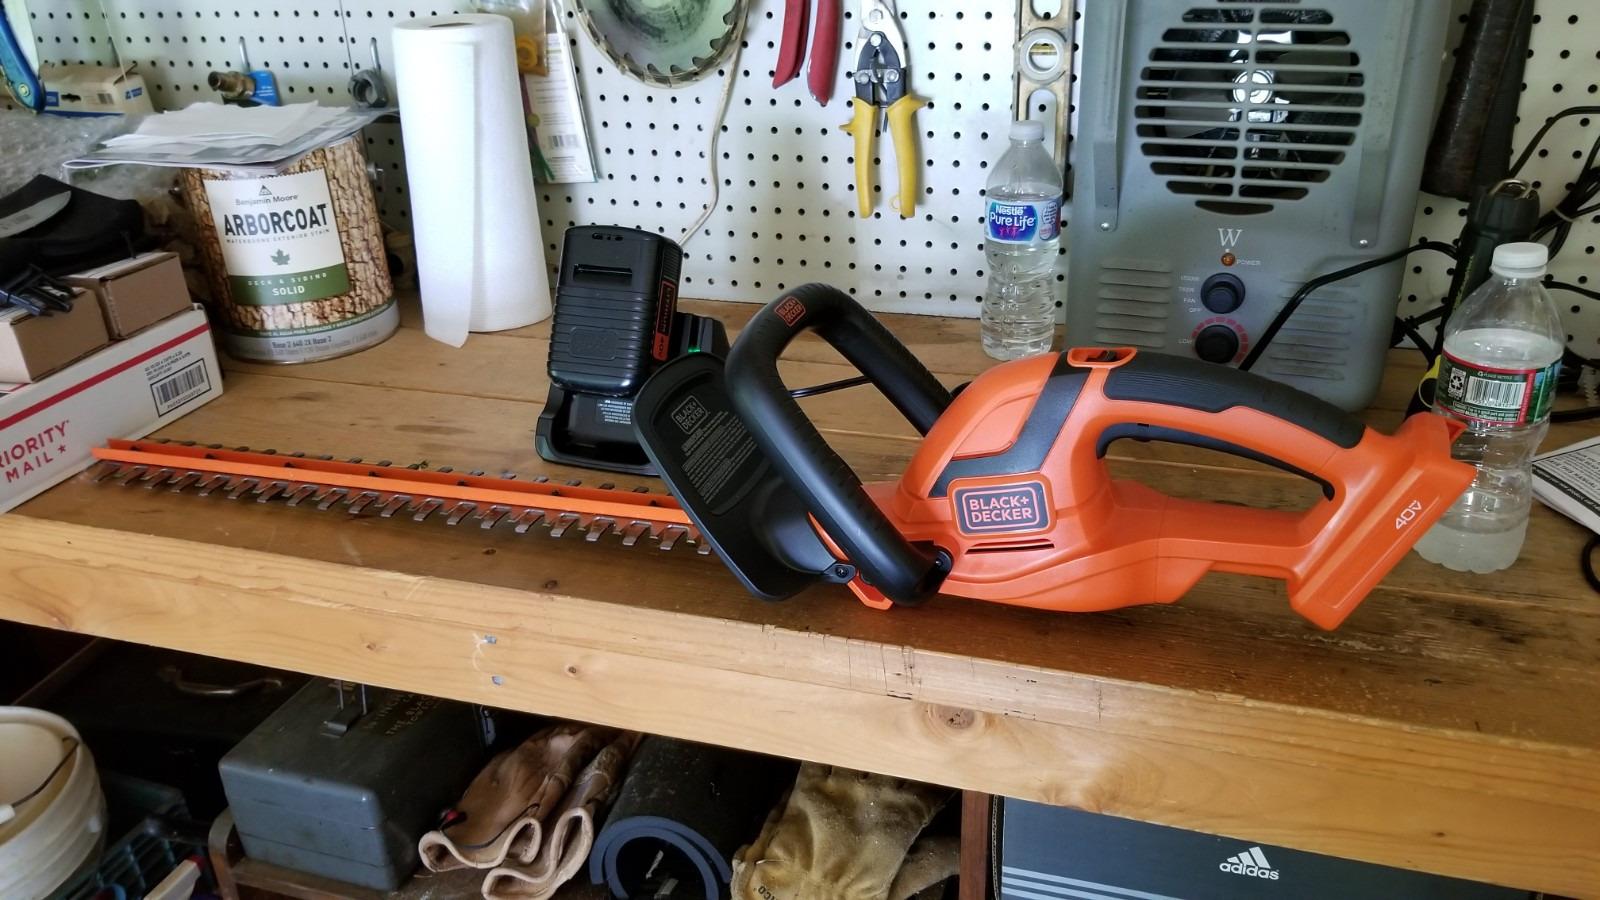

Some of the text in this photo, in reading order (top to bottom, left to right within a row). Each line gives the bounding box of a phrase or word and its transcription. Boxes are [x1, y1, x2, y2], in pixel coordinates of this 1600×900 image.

[235, 194, 298, 207] Benjamin Moore
[224, 203, 327, 236] ARBORCOAT
[990, 211, 1012, 226] Pure
[1013, 216, 1035, 231] Life
[1218, 228, 1243, 247] W
[247, 278, 272, 286] DECK
[272, 285, 305, 296] SOLID
[682, 407, 704, 429] DECKER
[6, 453, 54, 482] MAIL
[969, 496, 1030, 510] BLACK+
[971, 507, 1033, 523] DECKER
[1395, 500, 1422, 530] 40V
[1219, 862, 1280, 880] adidas
